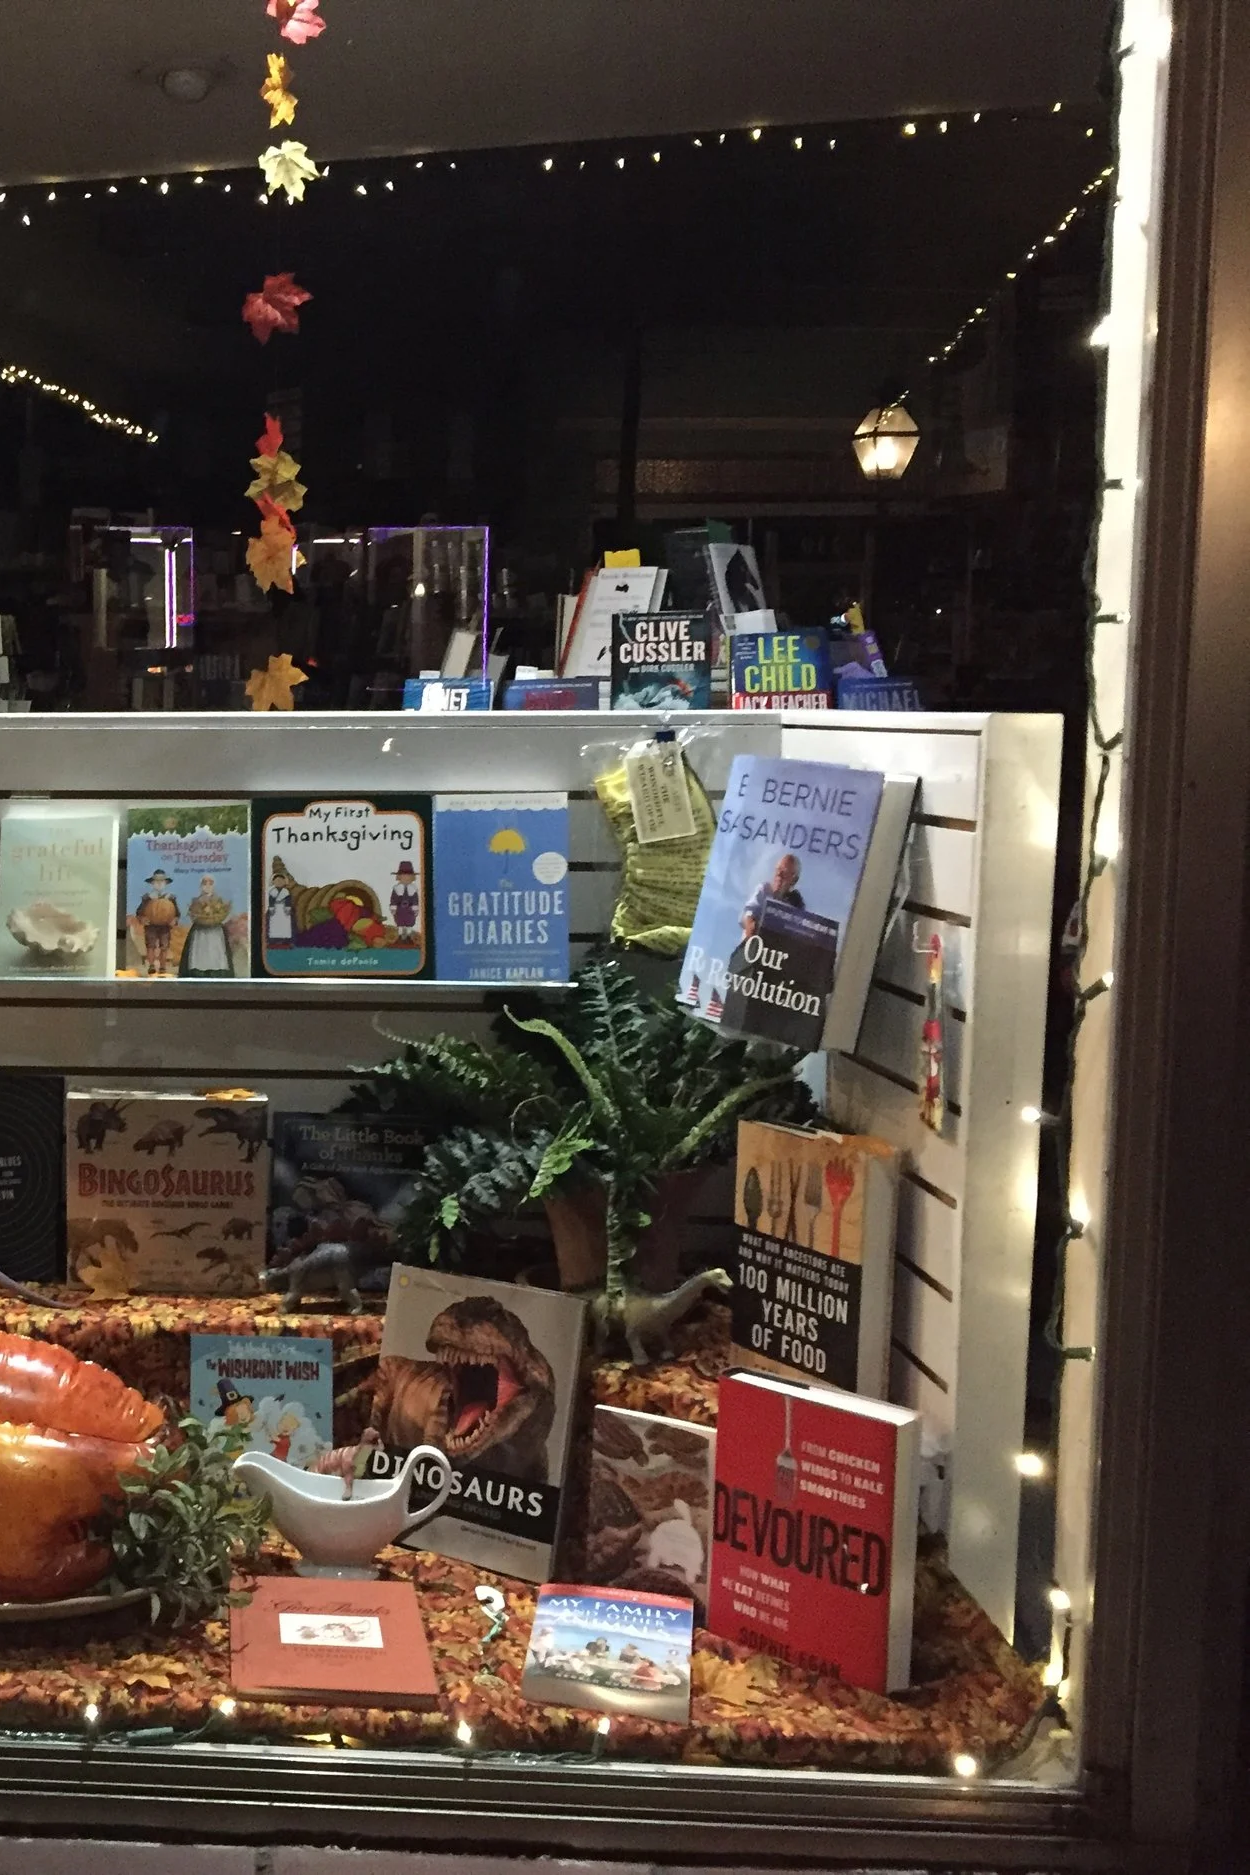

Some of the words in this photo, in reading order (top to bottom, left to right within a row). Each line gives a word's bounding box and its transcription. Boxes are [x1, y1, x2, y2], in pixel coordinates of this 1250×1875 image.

[635, 620, 691, 643] CLIVE
[619, 641, 706, 664] CUSSLER
[757, 635, 801, 665] LEE
[744, 663, 817, 694] CHILD
[771, 692, 828, 710] REACHER
[842, 688, 924, 711] MICHAEL
[761, 777, 858, 817] BERNIE
[308, 806, 331, 823] My
[334, 806, 371, 819] First
[146, 838, 224, 852] Thanksgiving
[272, 823, 414, 851] Thanksgiving
[739, 814, 862, 861] SANDERS
[174, 852, 229, 866] Thursday
[448, 890, 565, 917] GRATITUDE
[463, 919, 550, 945] DIARIES
[744, 934, 790, 972] Our
[469, 967, 502, 980] JANICE
[505, 967, 544, 980] KAPLAN
[706, 956, 821, 1017] Revolution
[300, 1124, 330, 1142] The
[333, 1126, 379, 1144] Little
[382, 1128, 425, 1145] Book
[319, 1144, 337, 1161] of
[742, 1233, 762, 1249] WHAT
[783, 1246, 828, 1272] ANCESTORS
[830, 1263, 846, 1279] ATE
[738, 1262, 768, 1295] 100
[775, 1275, 849, 1326] MILLION
[761, 1298, 819, 1343] YEARS
[751, 1322, 773, 1351] OF
[780, 1334, 828, 1375] FOOD
[218, 1357, 284, 1380] WISHBONE
[285, 1360, 320, 1381] WISH
[829, 1448, 881, 1474] CHICKEN
[371, 1450, 544, 1518] DINOSAURS
[801, 1459, 838, 1481] WINGS
[853, 1476, 885, 1496] KALE
[799, 1478, 866, 1510] SMOOTHIES
[712, 1479, 889, 1597] DEVOURED
[734, 1581, 753, 1598] EAT
[760, 1572, 791, 1593] WHAT
[549, 1598, 583, 1608] MY
[594, 1600, 681, 1621] FAMILY
[733, 1599, 757, 1619] WHO
